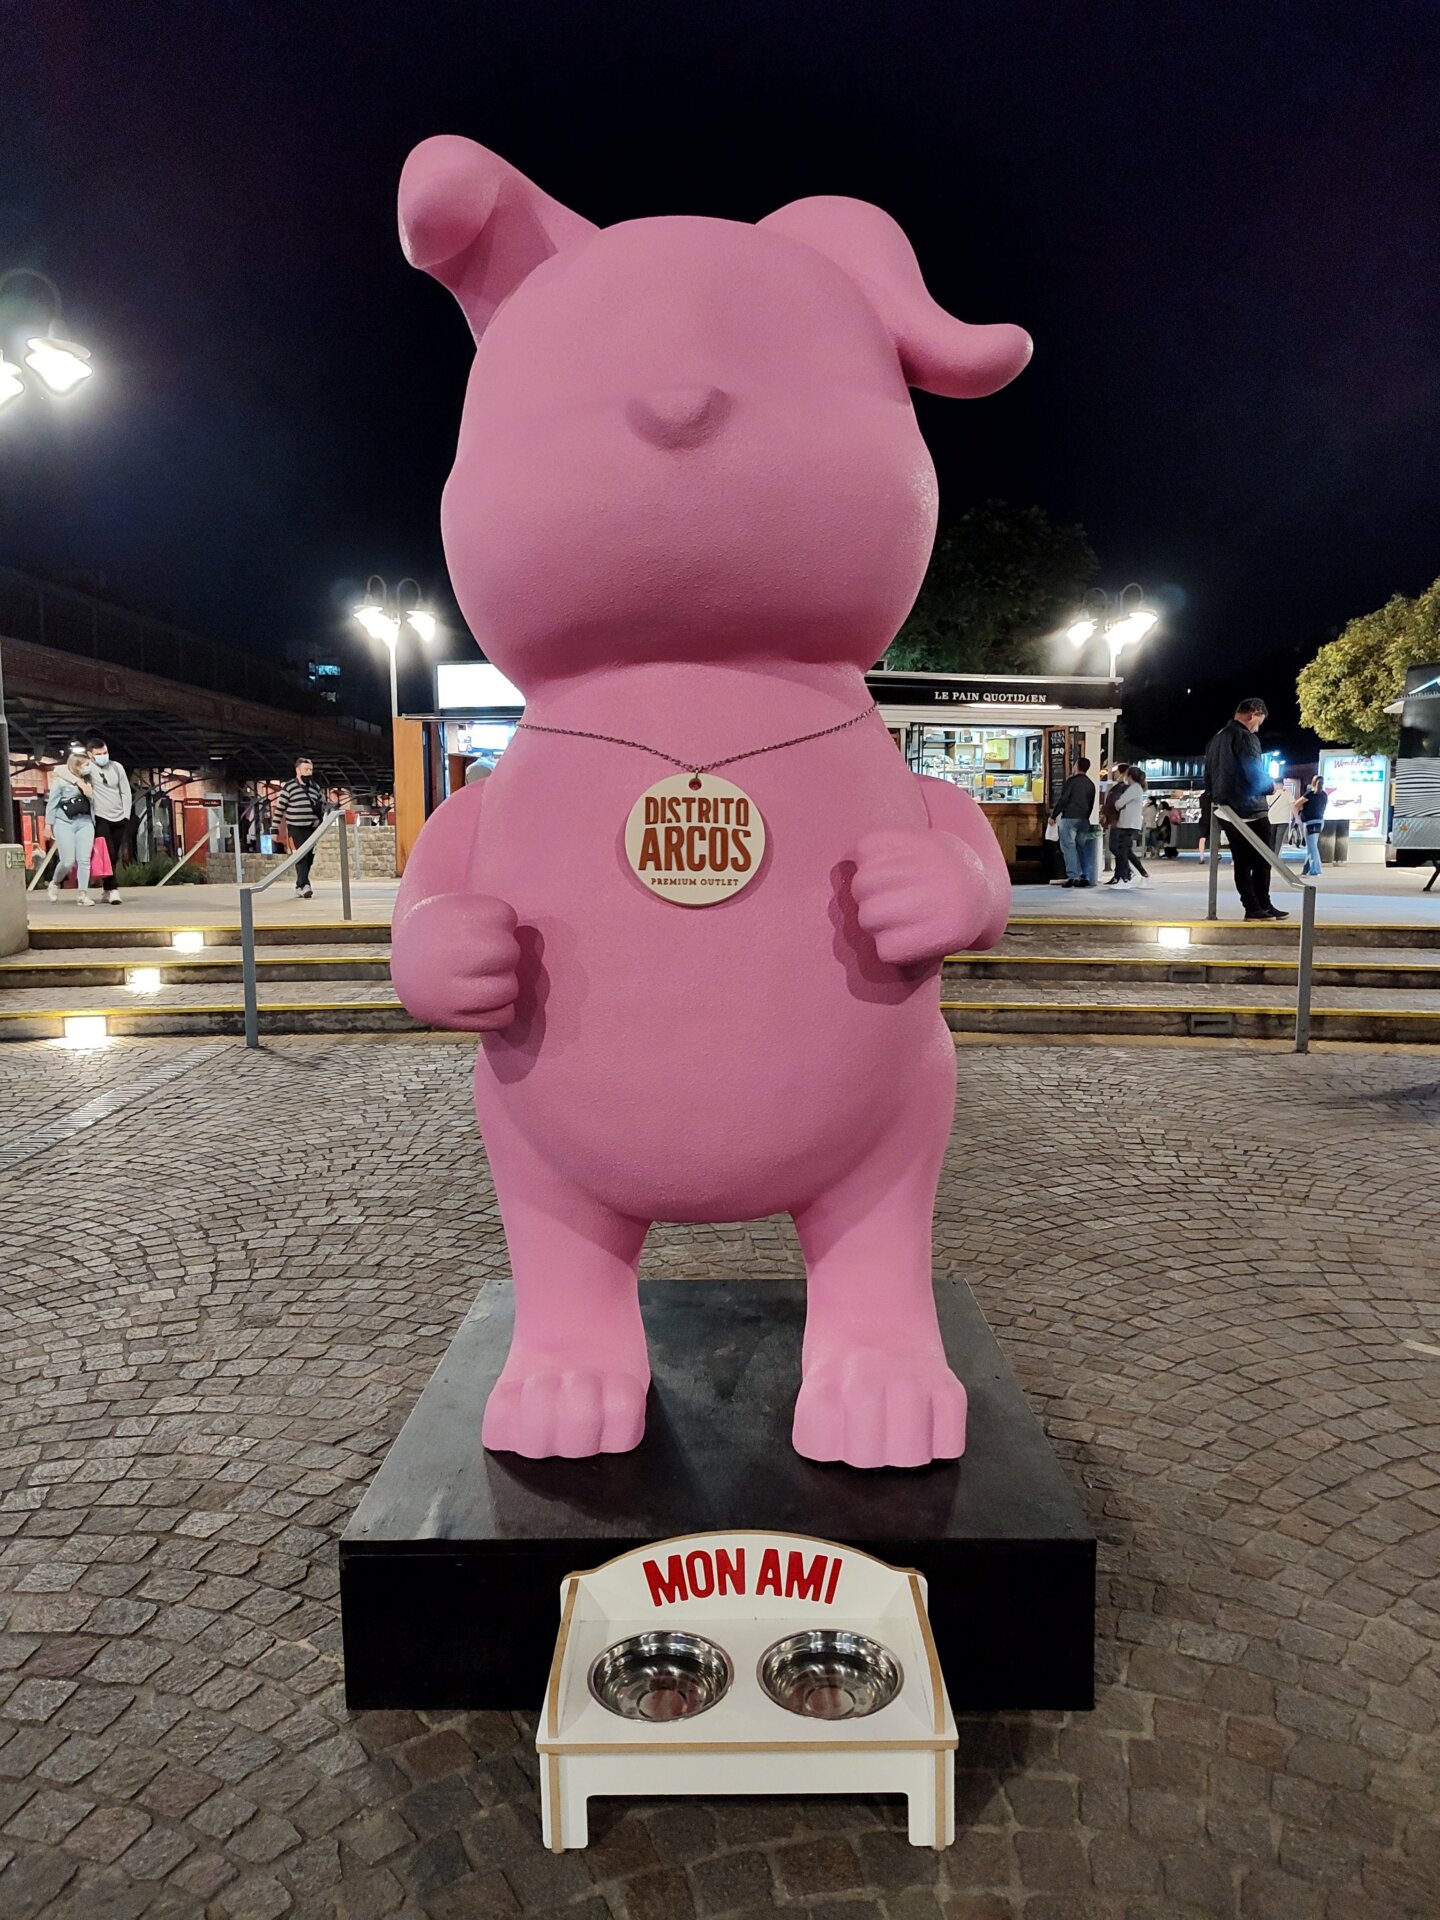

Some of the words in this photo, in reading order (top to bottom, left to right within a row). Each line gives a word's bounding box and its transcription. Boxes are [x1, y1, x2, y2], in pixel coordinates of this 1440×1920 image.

[934, 691, 949, 700] LE
[952, 692, 980, 701] PAIN
[983, 693, 1047, 703] QUOTIDIEN
[645, 797, 749, 826] DISTRITO
[638, 826, 752, 872] ARCOS
[651, 878, 697, 886] PREMIUM
[700, 878, 739, 886] OUTLET
[642, 1548, 746, 1607] MON
[755, 1548, 843, 1604] AMI
